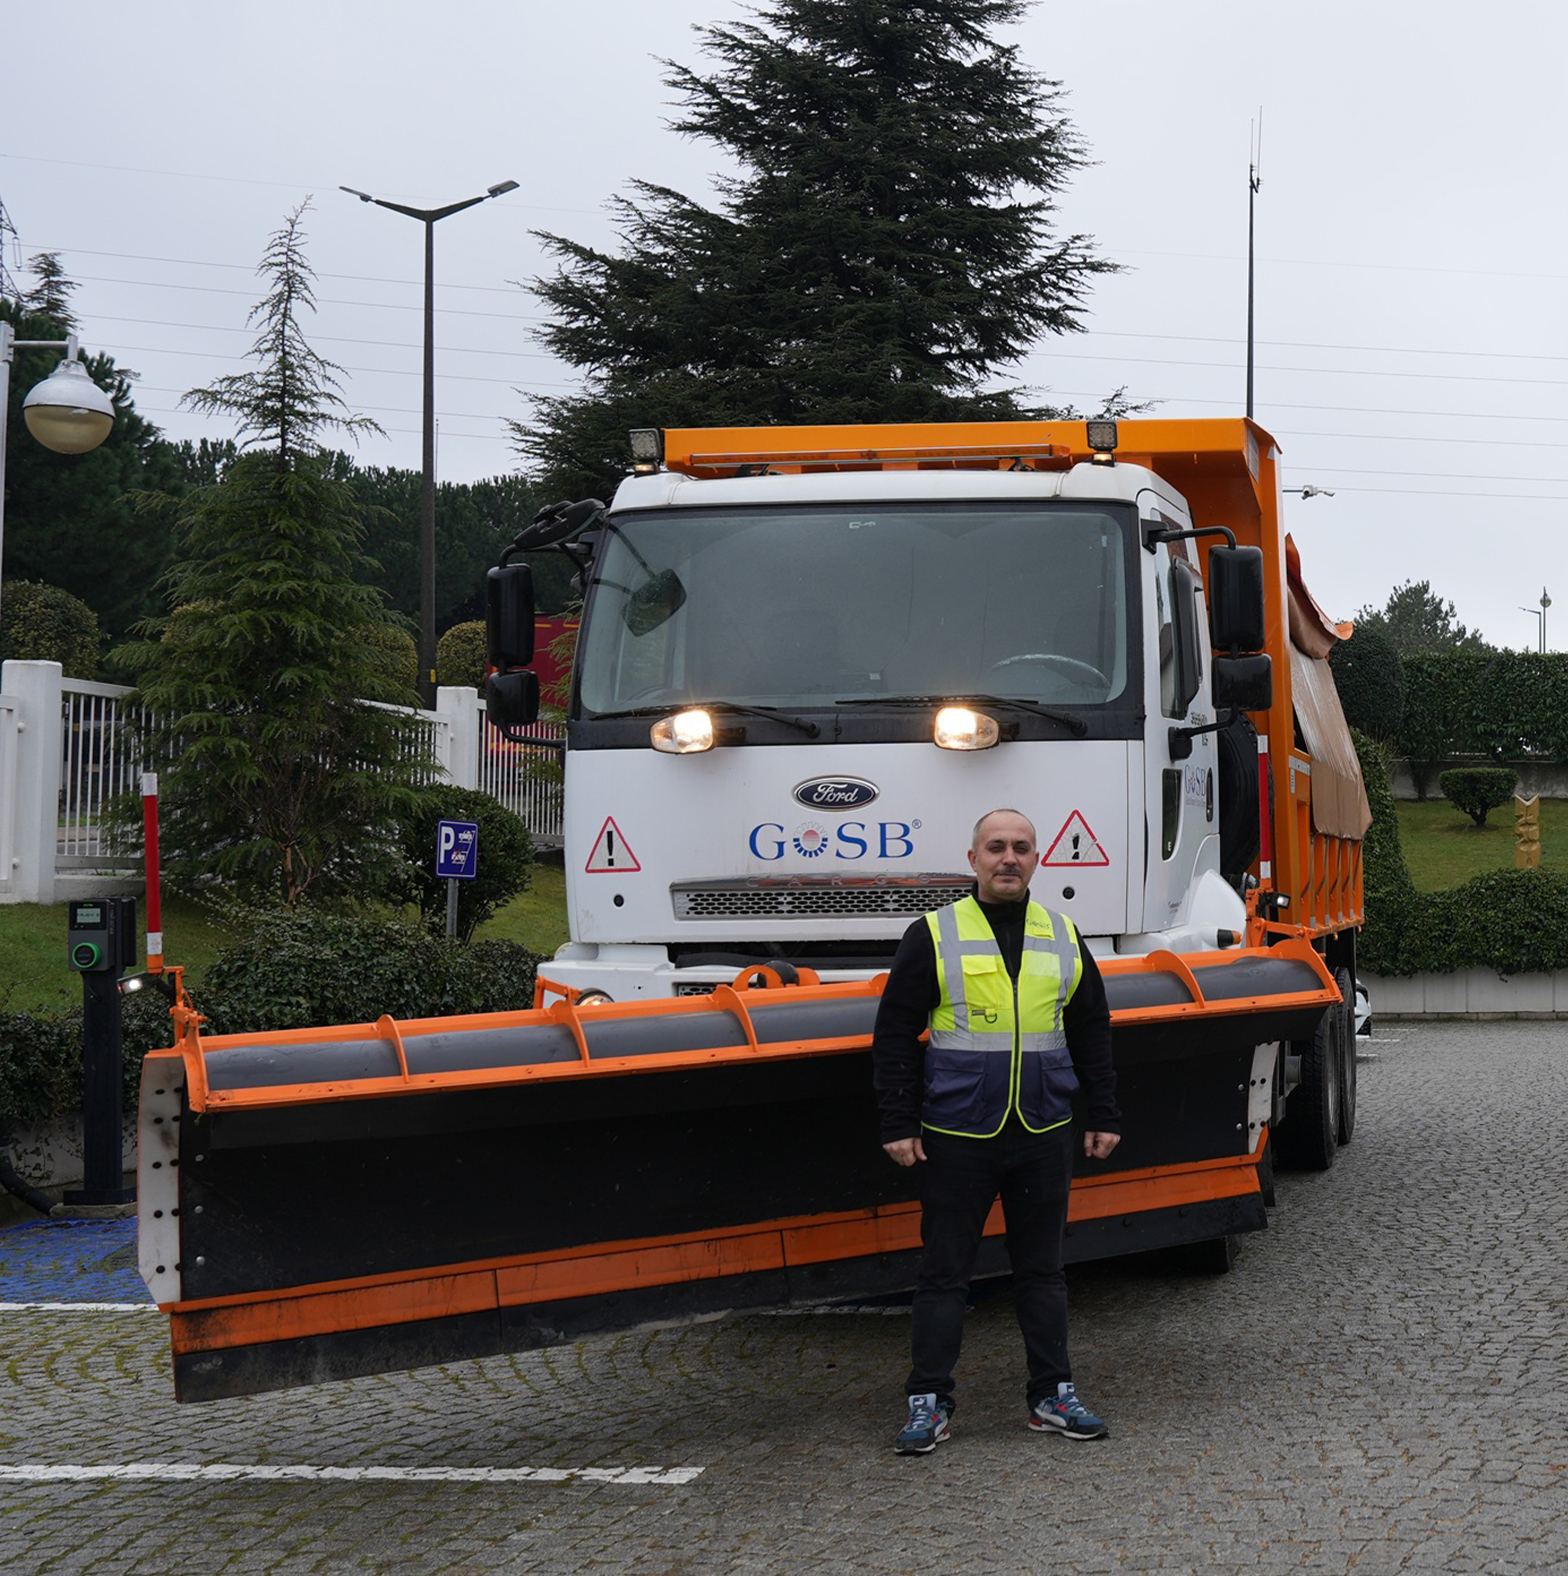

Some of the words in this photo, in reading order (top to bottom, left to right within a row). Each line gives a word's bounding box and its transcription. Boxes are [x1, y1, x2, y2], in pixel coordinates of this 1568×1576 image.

[812, 783, 859, 803] Ford
[440, 826, 455, 864] P
[747, 873, 932, 888] CARGO
